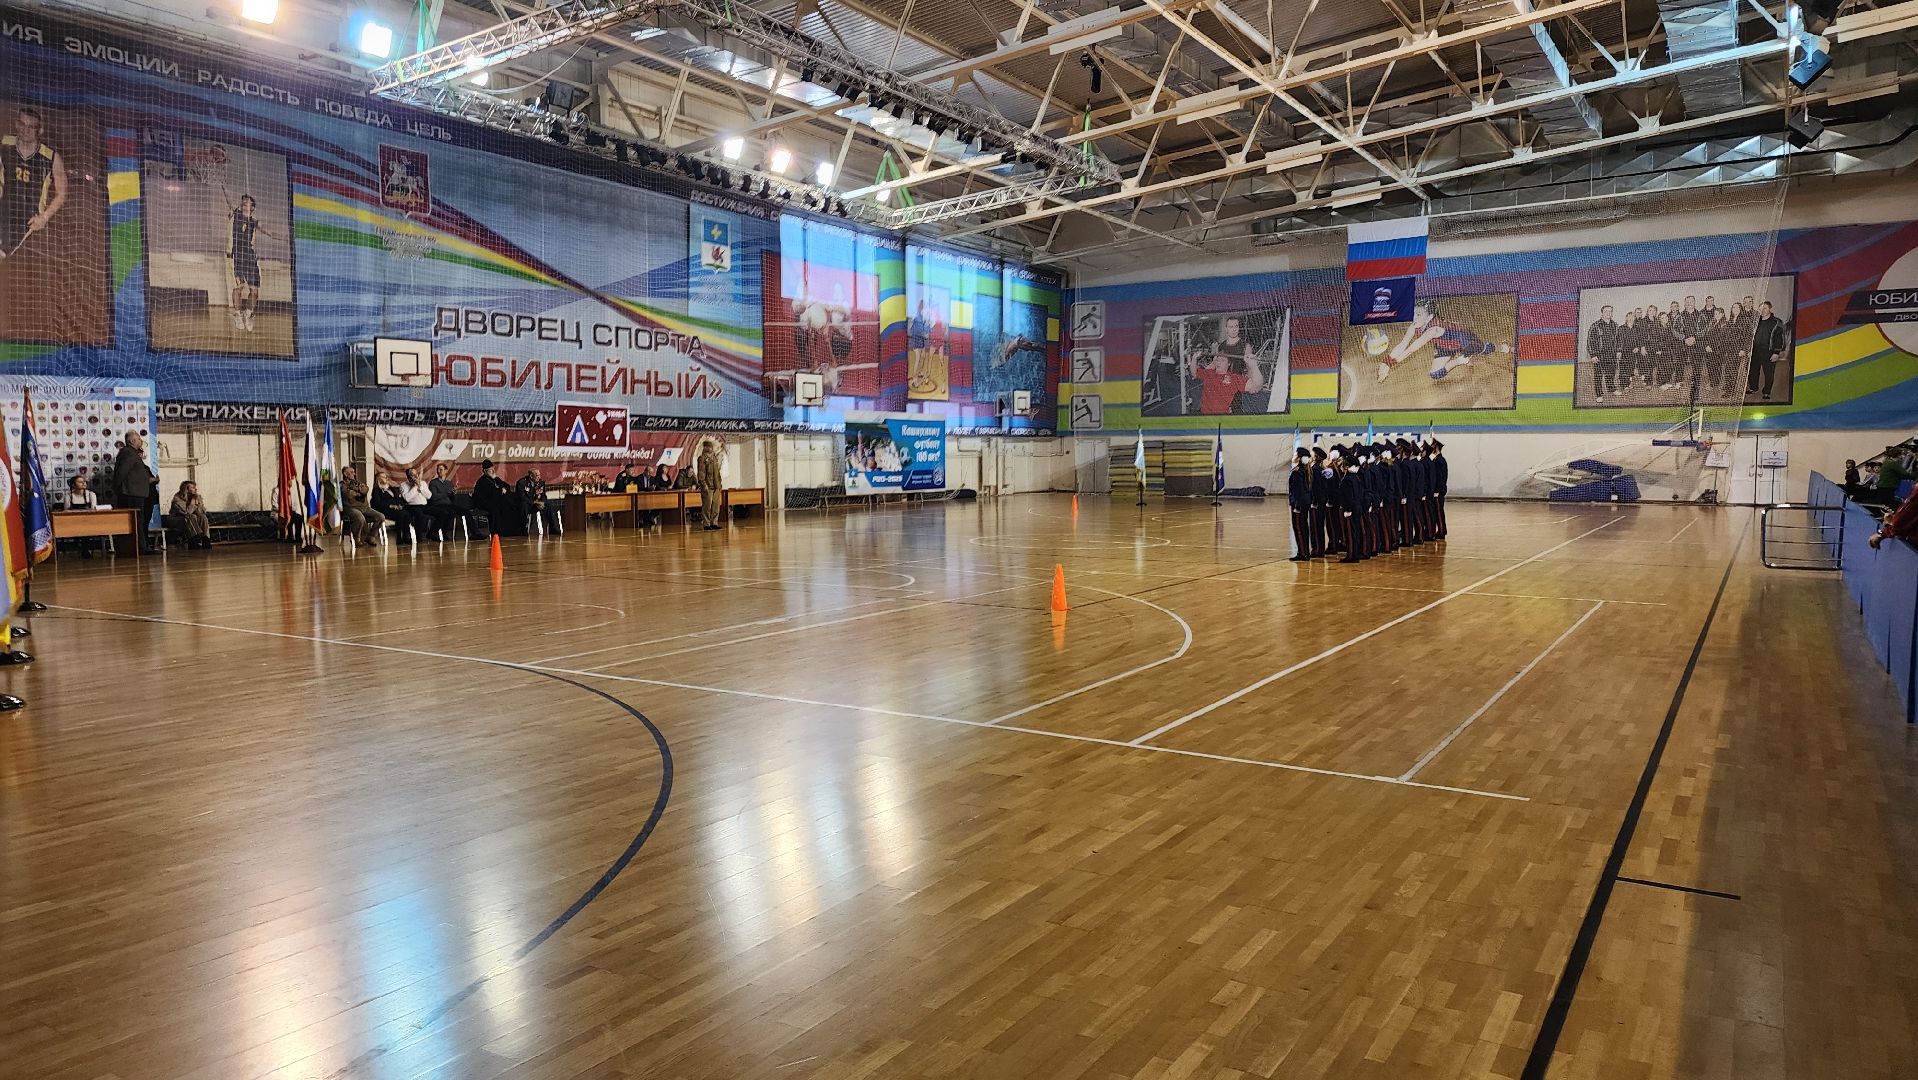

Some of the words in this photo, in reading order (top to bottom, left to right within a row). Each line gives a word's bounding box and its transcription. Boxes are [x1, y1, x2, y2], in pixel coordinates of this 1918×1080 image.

[64, 36, 179, 77] ЭМОЦИИ
[197, 69, 300, 105] РАДОСТЬ
[315, 98, 393, 128] ПОБЕДА
[406, 119, 452, 141] ЦЕЛЬ
[1869, 292, 1918, 306] ЮБИ
[432, 304, 584, 350] ДВОРЕЦ
[592, 322, 708, 358] СПОРТА
[156, 402, 308, 421] ДОСТИЖЕНИЯ
[328, 406, 425, 422] СМЕЛОСТЬ
[436, 410, 499, 426] РЕКОРД
[645, 416, 678, 428] СИЛА
[685, 418, 748, 431] ДИНАМИКА
[471, 443, 495, 459] ГТО
[508, 444, 536, 458] одна
